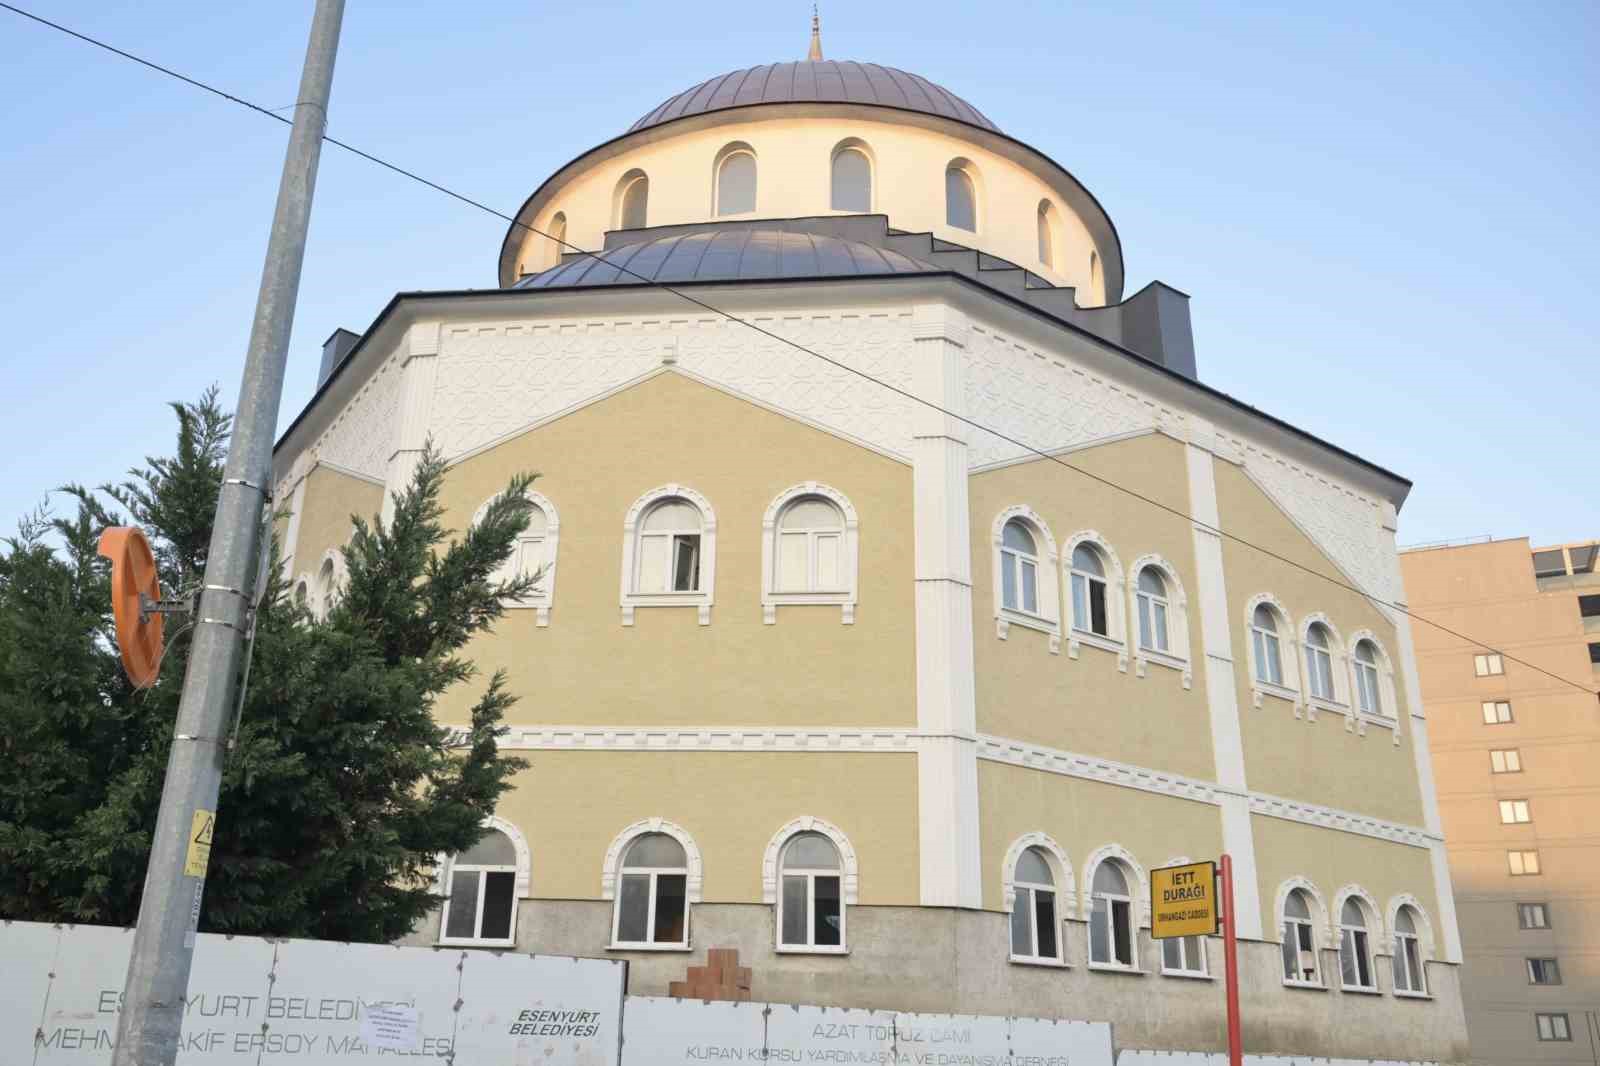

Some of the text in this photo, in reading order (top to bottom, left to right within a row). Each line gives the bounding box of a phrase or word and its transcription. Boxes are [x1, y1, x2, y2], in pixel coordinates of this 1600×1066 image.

[1163, 883, 1205, 901] DURAĞI
[517, 1009, 600, 1023] ESENYURT
[508, 1023, 600, 1037] BELEDİYESİ
[812, 1023, 859, 1039] AZAT
[233, 1032, 319, 1054] ERSOY
[685, 1046, 743, 1061] KURAN
[748, 1047, 802, 1062] KURSU
[915, 1052, 935, 1066] VE
